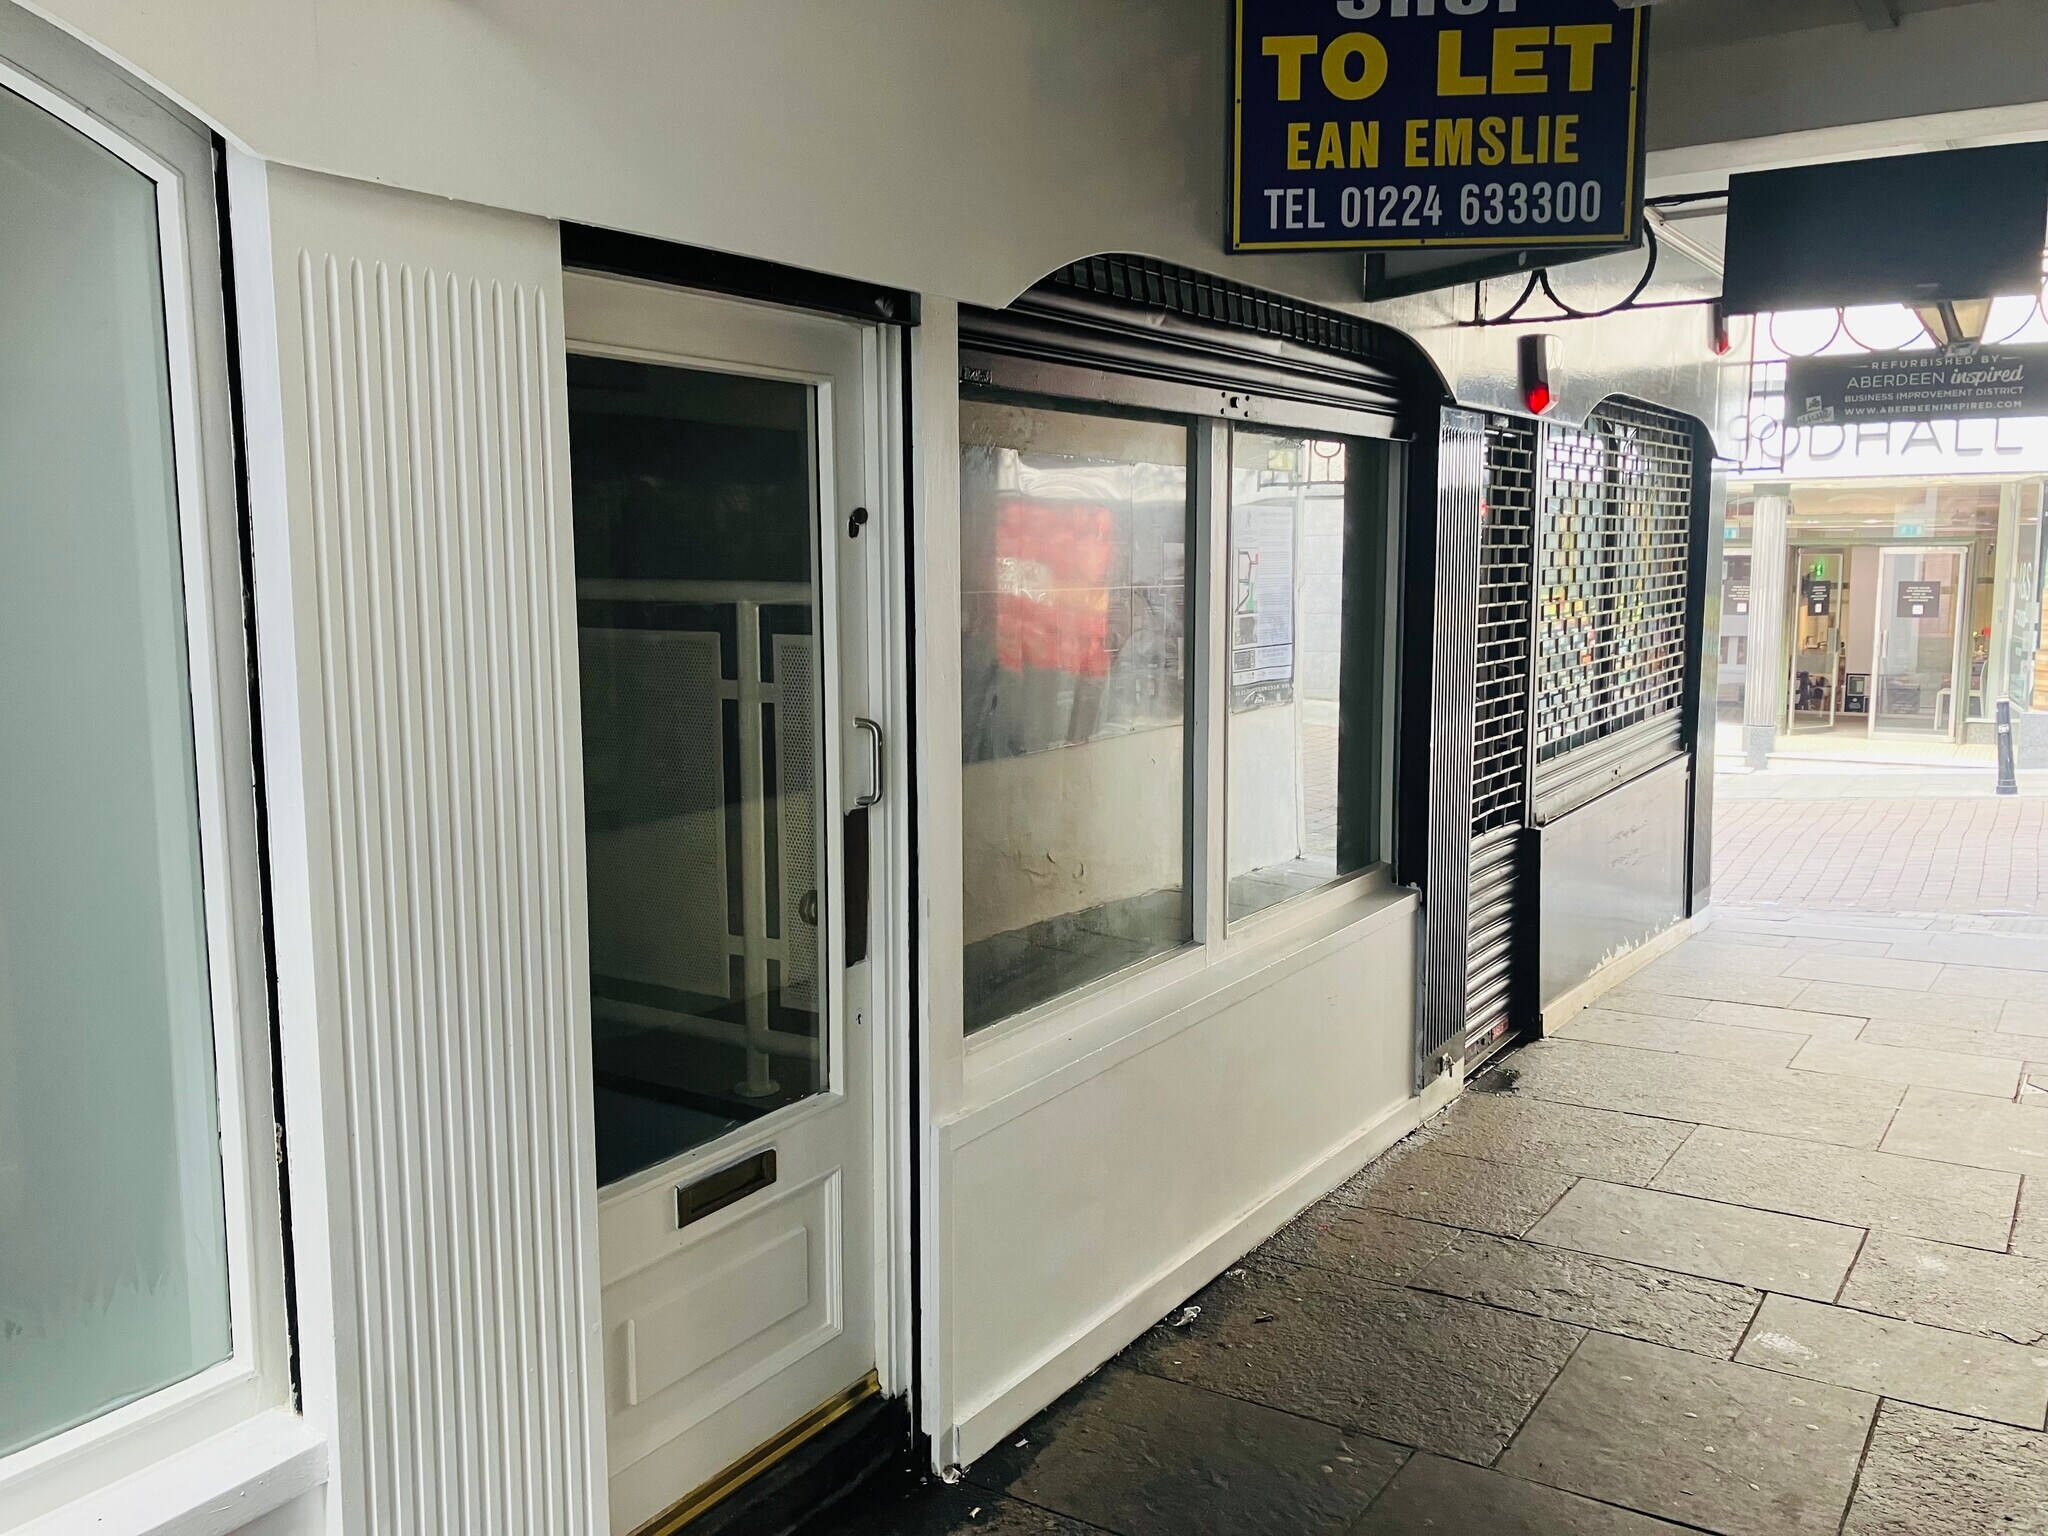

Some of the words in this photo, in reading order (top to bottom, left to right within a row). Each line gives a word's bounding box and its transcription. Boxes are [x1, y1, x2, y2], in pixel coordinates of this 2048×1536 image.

[1262, 32, 1388, 101] TO
[1437, 24, 1612, 96] LET
[1287, 120, 1379, 170] EAN
[1405, 114, 1579, 168] EMSLIE
[1264, 188, 1325, 229] TEL
[1340, 184, 1442, 228] 01224
[1460, 180, 1601, 225] 633300
[1871, 355, 1973, 370] REFURBISHED
[1981, 354, 1999, 364] BY
[1846, 371, 1945, 389] ABERDEEN
[1950, 364, 2024, 387] inspired
[1844, 393, 1894, 403] BUSINESS
[1896, 388, 1974, 400] IMPROVEMENT
[1975, 386, 2024, 396] DISTRICT
[1844, 400, 2022, 416] WWW.ABERDEENINSPIRED.COM
